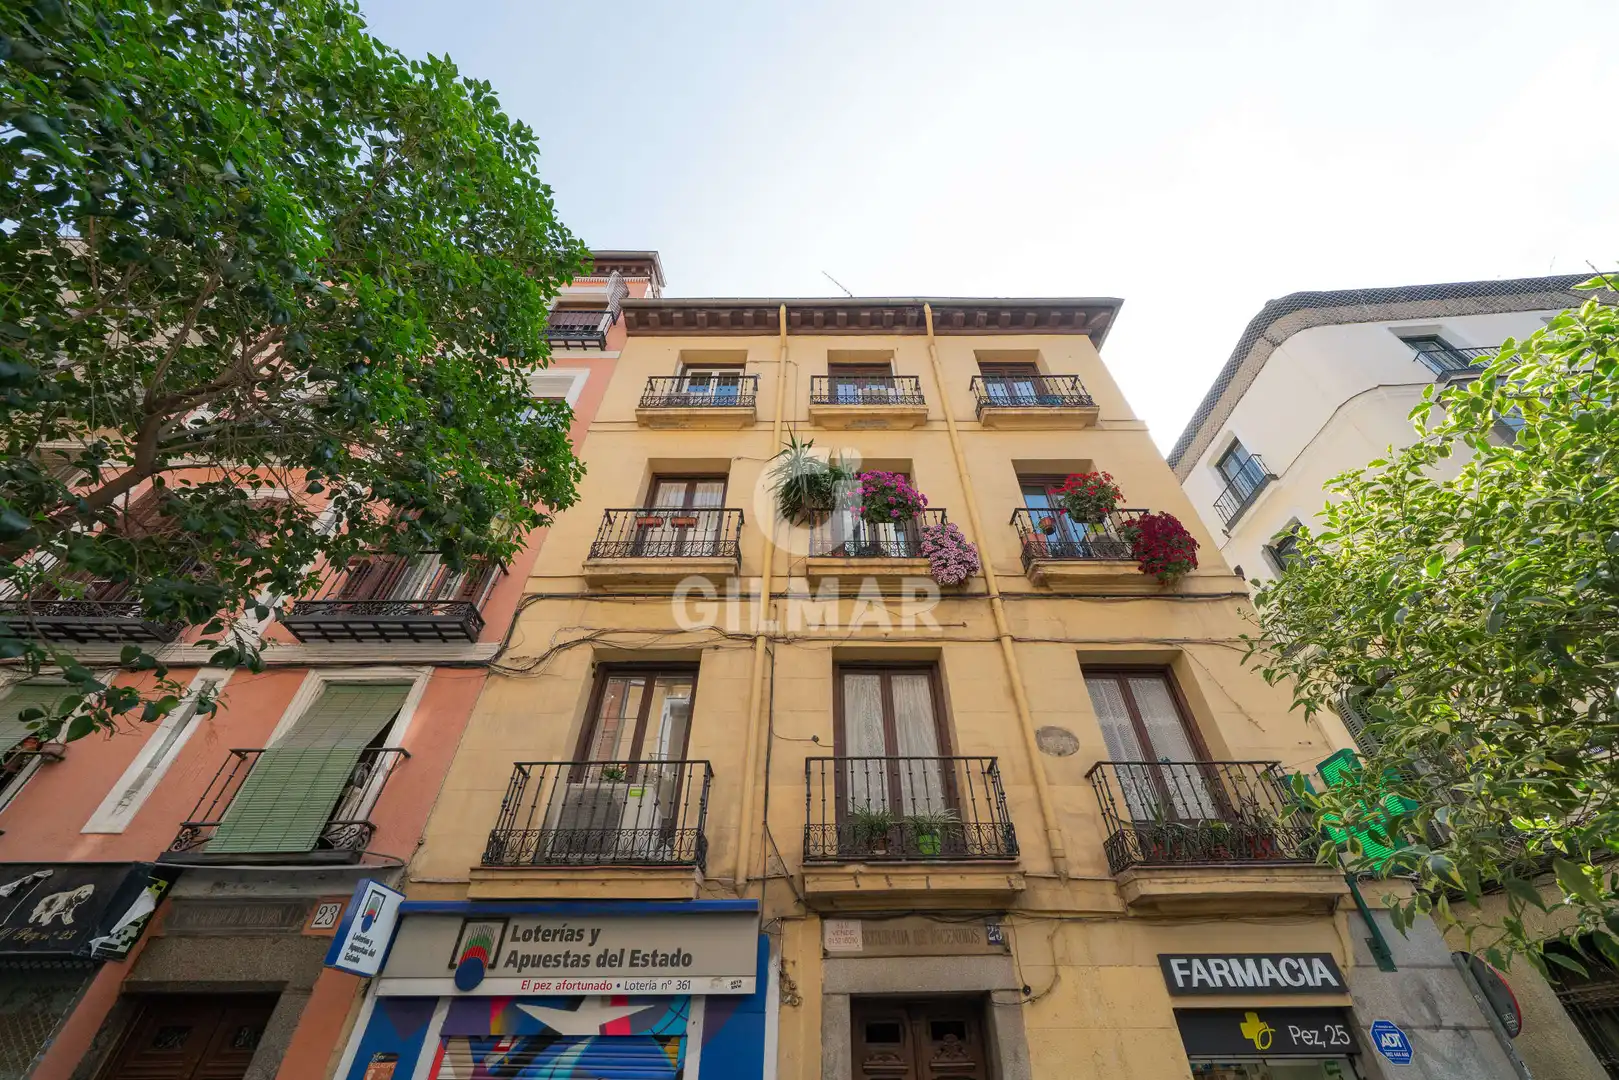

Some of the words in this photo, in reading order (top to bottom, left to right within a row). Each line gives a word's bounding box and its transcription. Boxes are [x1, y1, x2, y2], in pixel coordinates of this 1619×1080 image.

[314, 904, 338, 926] 23
[510, 923, 585, 943] Loterías
[588, 928, 601, 947] y
[503, 949, 591, 974] Apuestas
[596, 948, 625, 968] del
[628, 947, 693, 968] Estado
[1170, 957, 1340, 988] FARMACIA
[521, 980, 531, 991] El
[532, 982, 552, 992] pez
[555, 980, 613, 991] afortunado
[675, 980, 691, 991] 361
[1288, 1025, 1326, 1048] Pez,
[1324, 1024, 1350, 1045] 25
[1381, 1033, 1403, 1048] ADT
